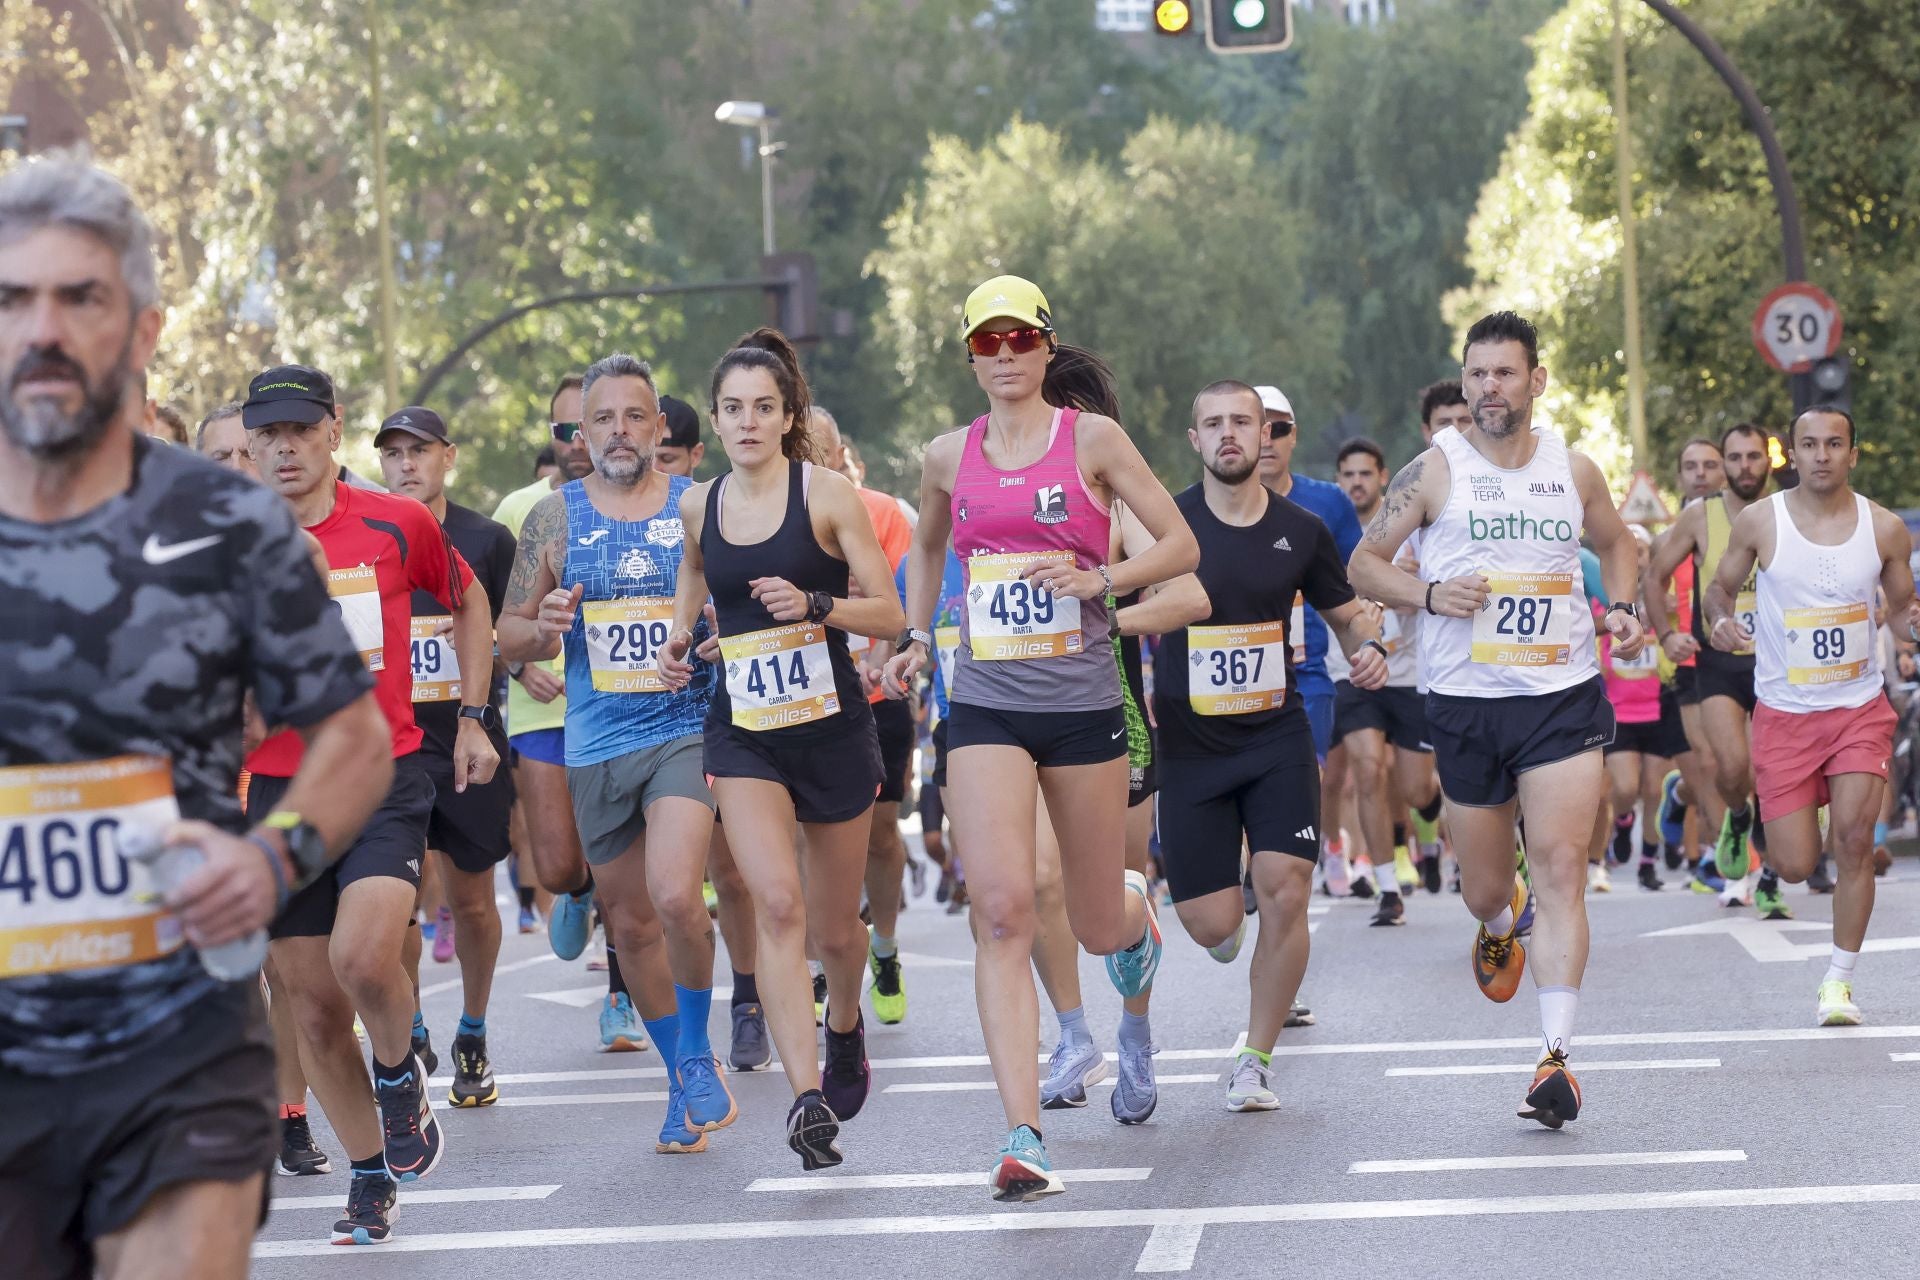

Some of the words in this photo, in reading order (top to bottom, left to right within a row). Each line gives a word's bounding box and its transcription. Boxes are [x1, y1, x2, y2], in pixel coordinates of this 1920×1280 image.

[1776, 313, 1818, 343] 30
[258, 382, 309, 392] cannondale
[1470, 475, 1502, 484] bathco
[1528, 480, 1565, 494] JULIÁN
[1472, 490, 1505, 501] TEAM
[1468, 509, 1573, 542] bathco
[651, 529, 685, 538] VETUSTA
[1006, 567, 1024, 577] 202
[1518, 584, 1539, 593] 2024
[989, 581, 1054, 626] 439
[625, 610, 648, 618] 2024
[1496, 596, 1553, 636] 287
[1012, 626, 1033, 635] MARTA
[607, 621, 668, 662] 299
[760, 640, 782, 651] 2024
[1226, 636, 1249, 645] 2024
[1812, 627, 1846, 660] 89
[411, 639, 441, 674] 49
[628, 662, 650, 671] BLASKY
[1210, 647, 1265, 687] 367
[411, 674, 428, 682] STIAN
[746, 650, 811, 698] 414
[1231, 685, 1248, 694] DIEGO
[768, 693, 794, 707] CARMEN
[0, 817, 130, 904] 460
